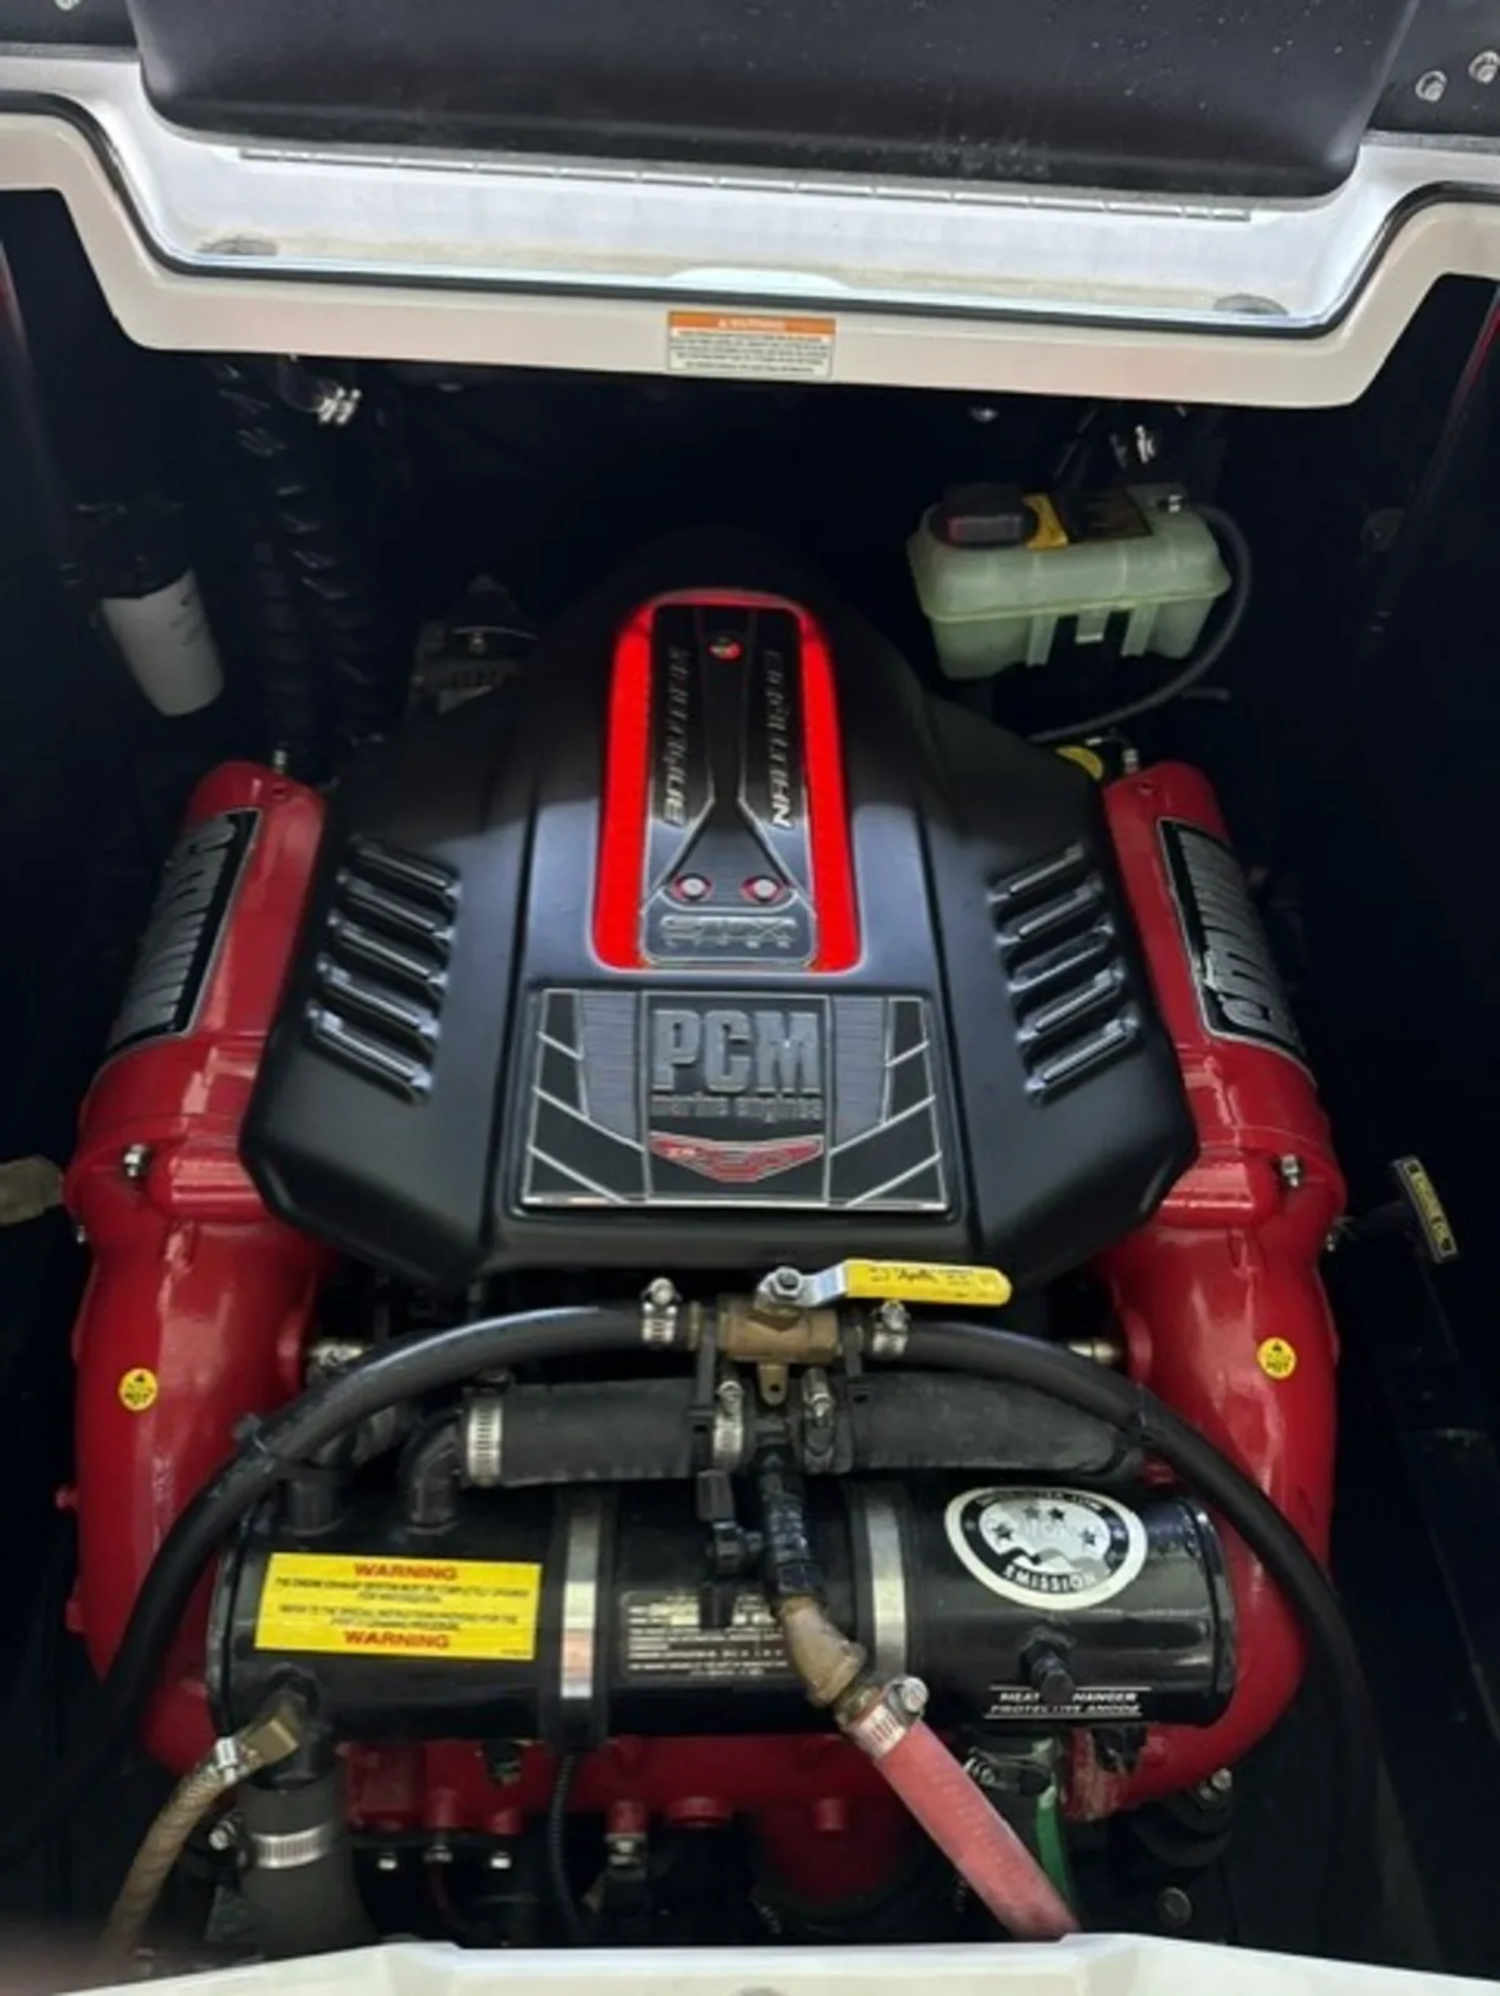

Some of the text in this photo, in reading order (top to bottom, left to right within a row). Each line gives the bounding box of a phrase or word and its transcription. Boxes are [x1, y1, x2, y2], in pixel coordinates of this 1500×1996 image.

[652, 1009, 821, 1093] PCM
[355, 1562, 458, 1581] WARNING
[343, 1630, 449, 1649] WARNING
